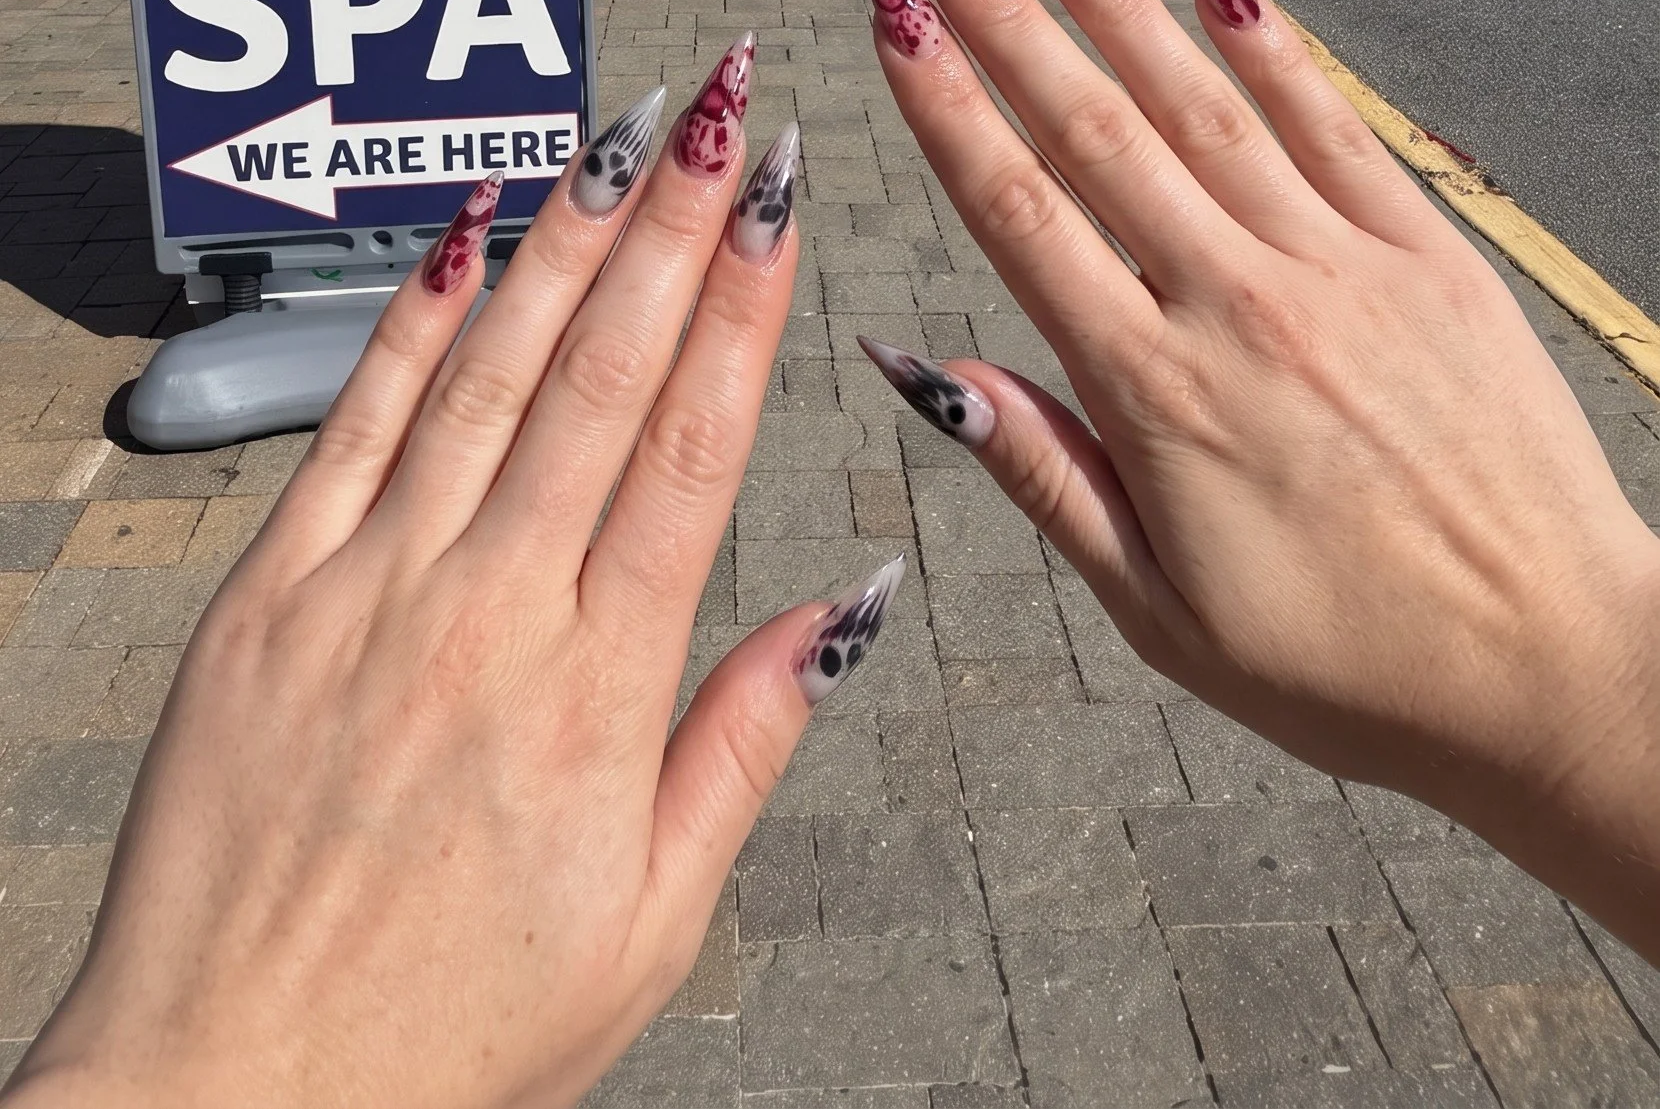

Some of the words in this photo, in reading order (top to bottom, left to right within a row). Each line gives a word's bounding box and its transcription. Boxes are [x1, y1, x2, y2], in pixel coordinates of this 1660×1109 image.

[226, 142, 312, 182] WE
[325, 135, 427, 178] ARE
[442, 129, 572, 172] HERE
